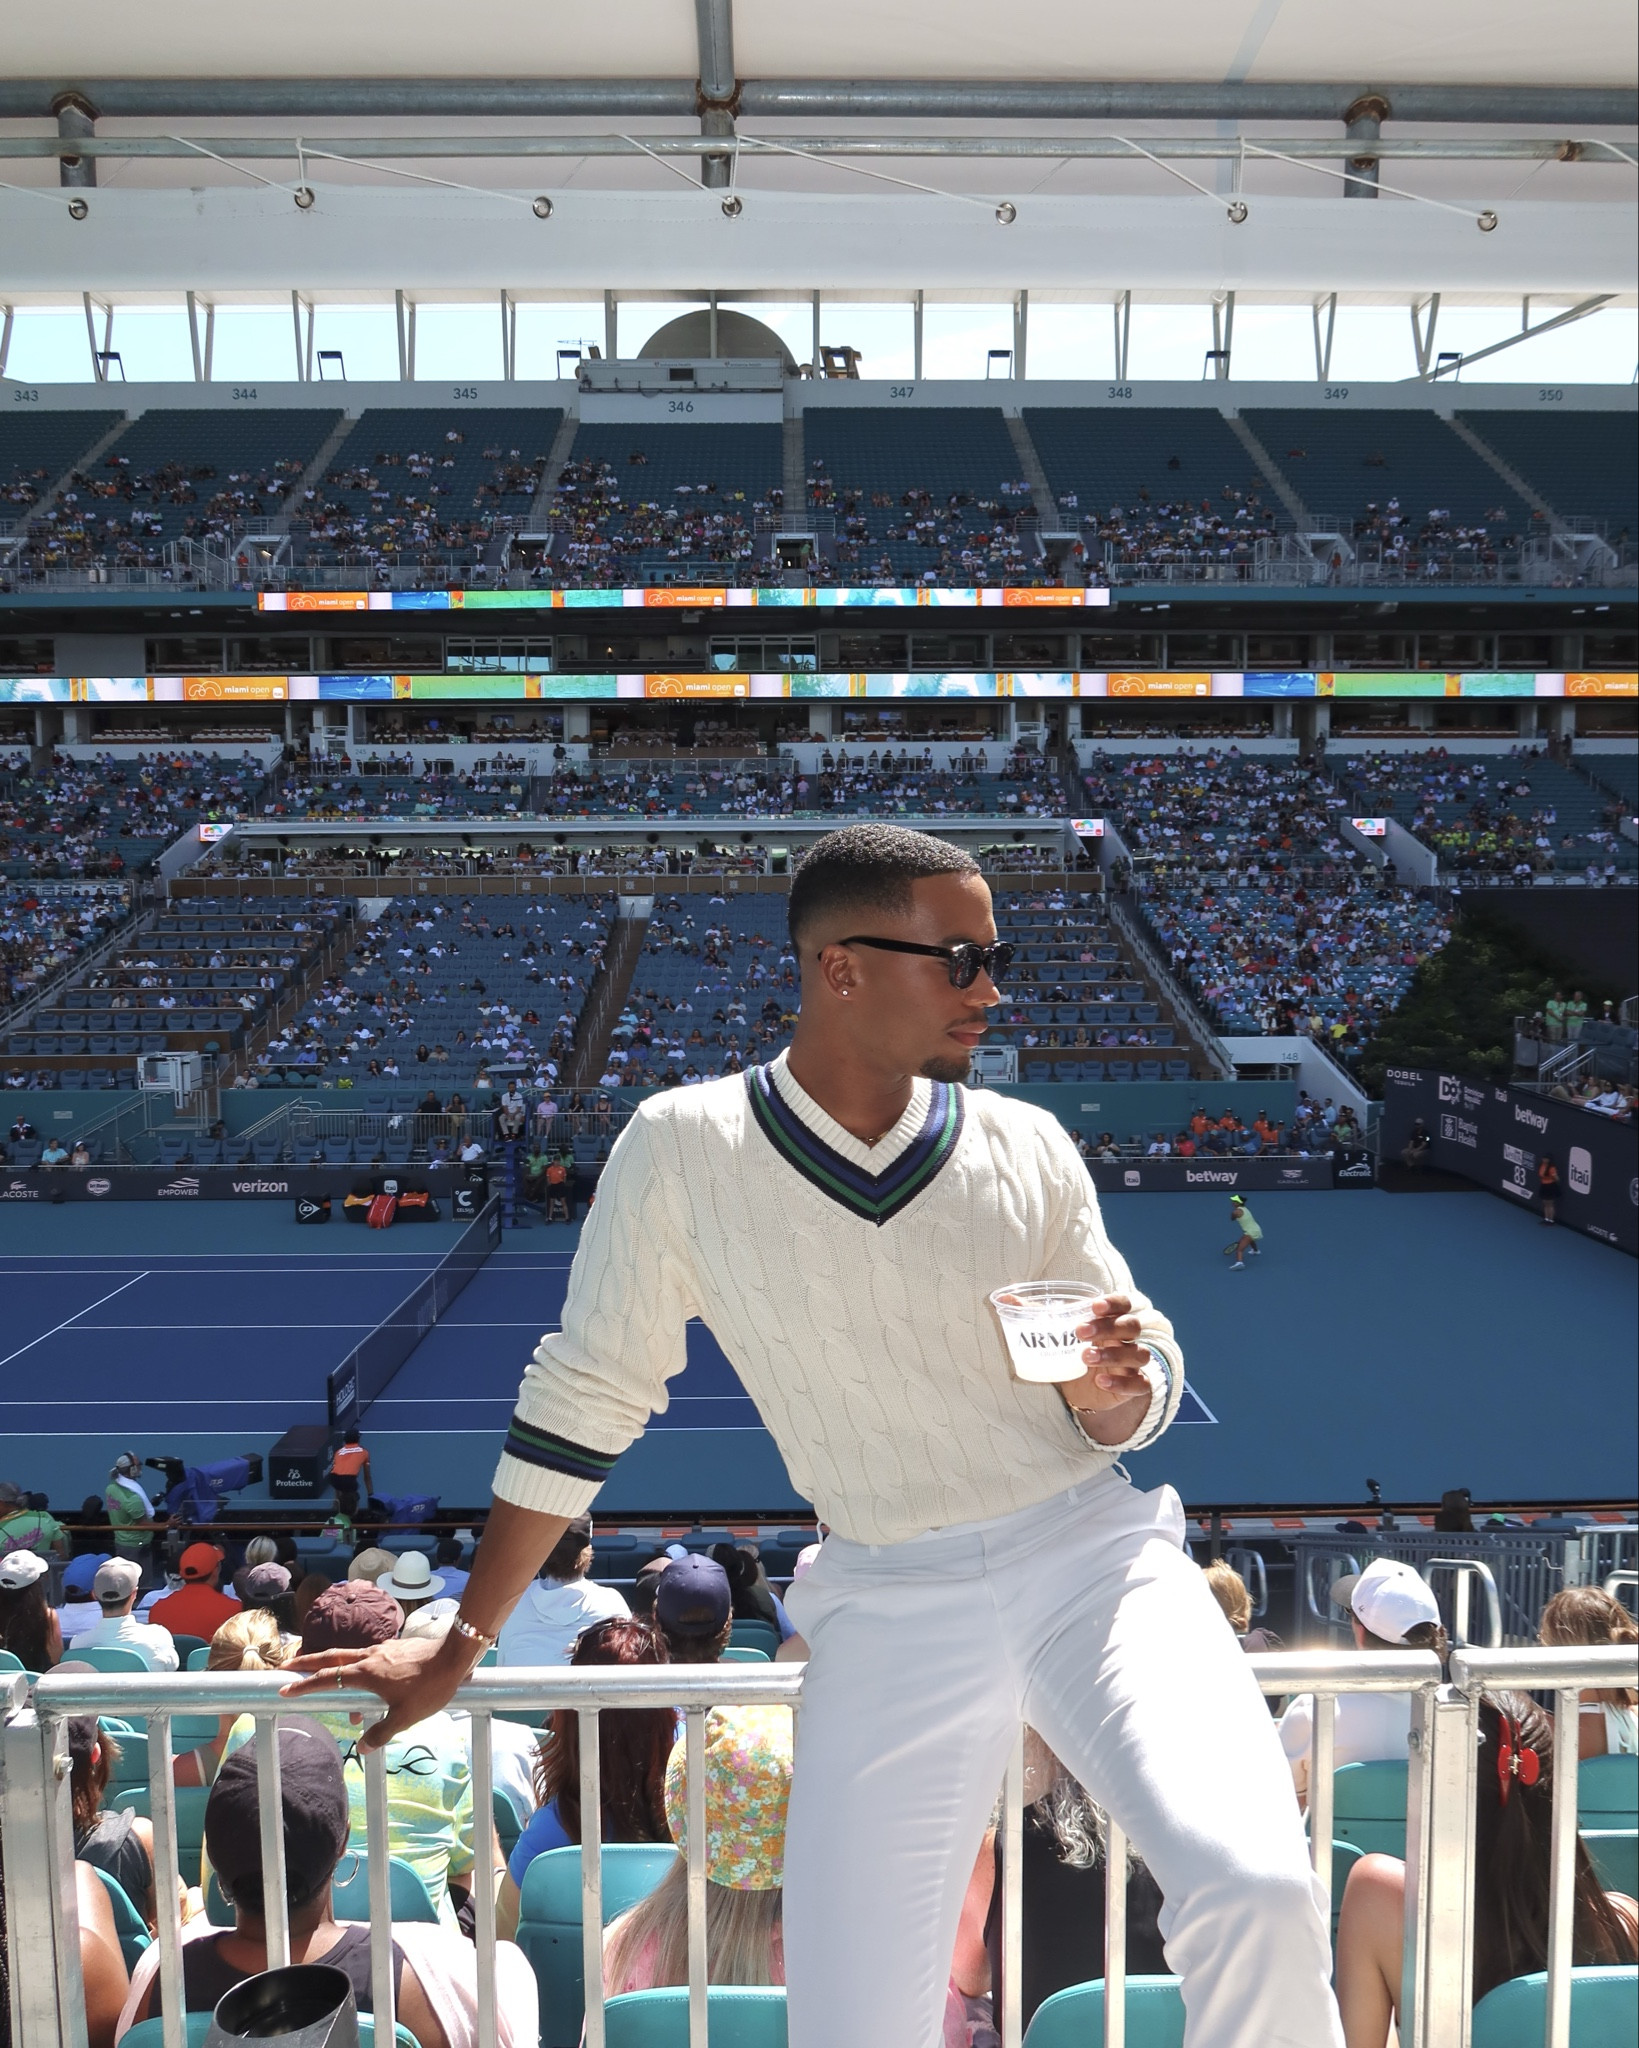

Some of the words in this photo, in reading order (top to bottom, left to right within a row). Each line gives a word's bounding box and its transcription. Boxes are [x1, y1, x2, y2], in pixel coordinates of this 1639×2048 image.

[14, 389, 39, 402] 343
[231, 388, 258, 400] 344
[453, 387, 478, 400] 345
[890, 386, 914, 399] 347
[1107, 386, 1133, 399] 348
[1324, 387, 1349, 400] 349
[1538, 388, 1564, 401] 350
[668, 400, 694, 414] 346
[339, 599, 355, 607] open
[696, 595, 712, 603] open
[224, 686, 249, 694] miami
[250, 686, 270, 696] open
[685, 683, 711, 692] miami
[712, 684, 731, 693] open
[1148, 682, 1173, 690] miami
[1173, 683, 1193, 692] open
[1604, 682, 1629, 690] miami
[1281, 1052, 1299, 1061] 148
[1386, 1069, 1423, 1081] DOBEL
[1514, 1104, 1549, 1134] betway
[1186, 1170, 1238, 1185] betway
[1513, 1165, 1527, 1186] 83
[157, 1188, 199, 1196] EMPOWER
[232, 1179, 288, 1193] verizon
[0, 1190, 39, 1198] ACOSTE
[1586, 1223, 1609, 1239] LACOSTE
[275, 1478, 314, 1488] Protective
